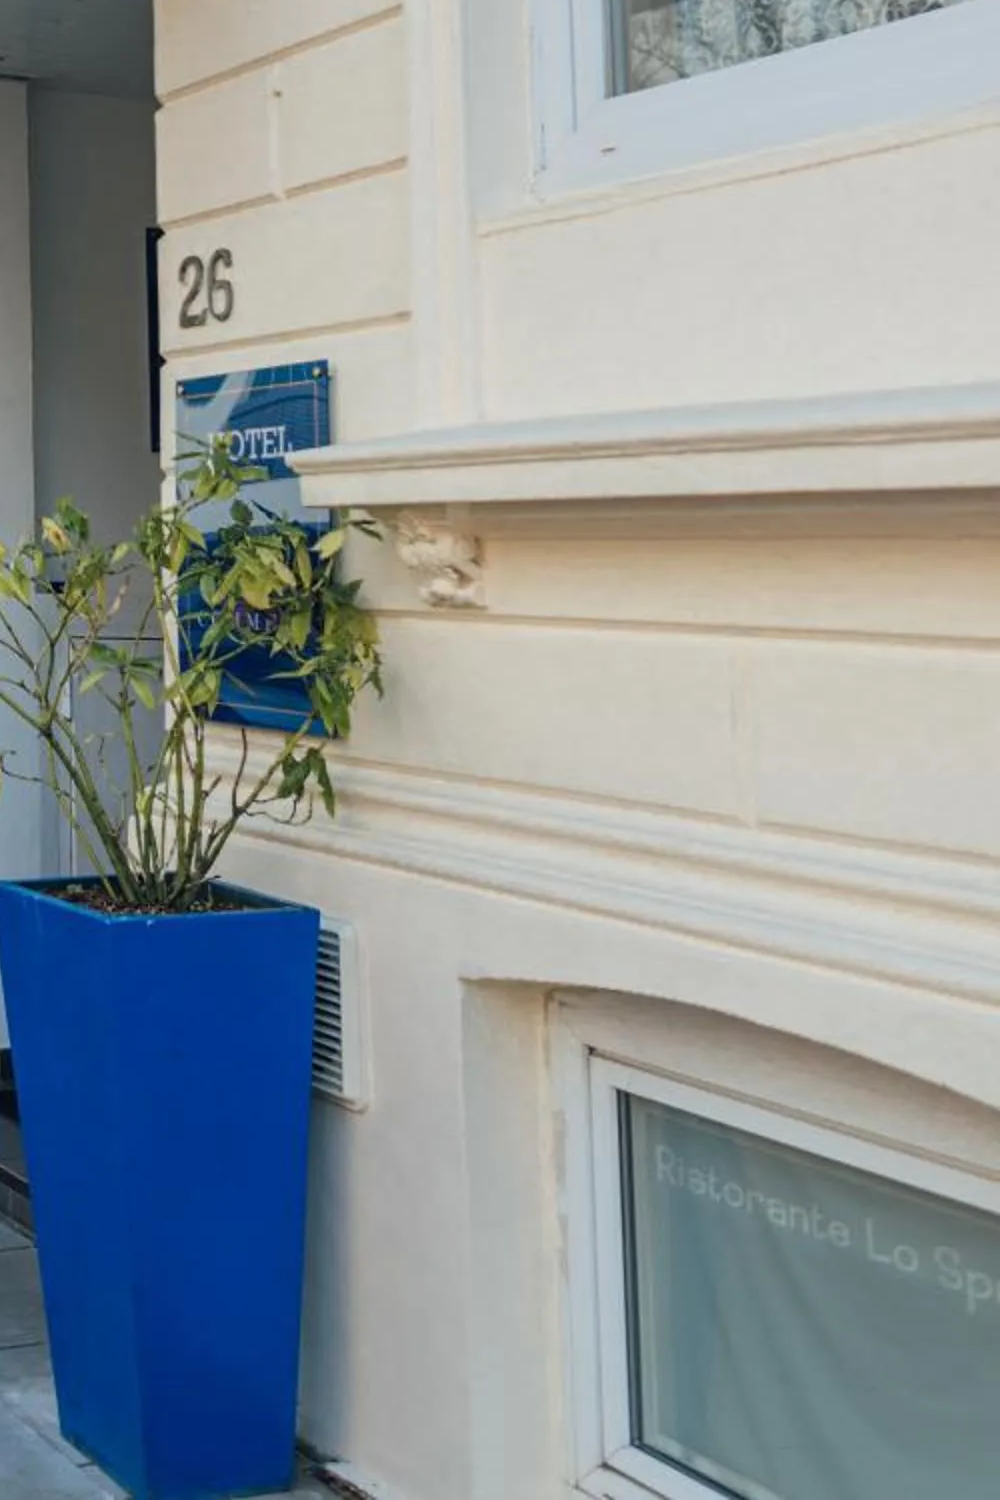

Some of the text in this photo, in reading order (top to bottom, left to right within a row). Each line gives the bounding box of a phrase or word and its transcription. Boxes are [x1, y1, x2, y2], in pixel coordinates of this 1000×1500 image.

[178, 247, 234, 329] 26
[655, 1144, 1000, 1316] Ristorante Lo Sp
